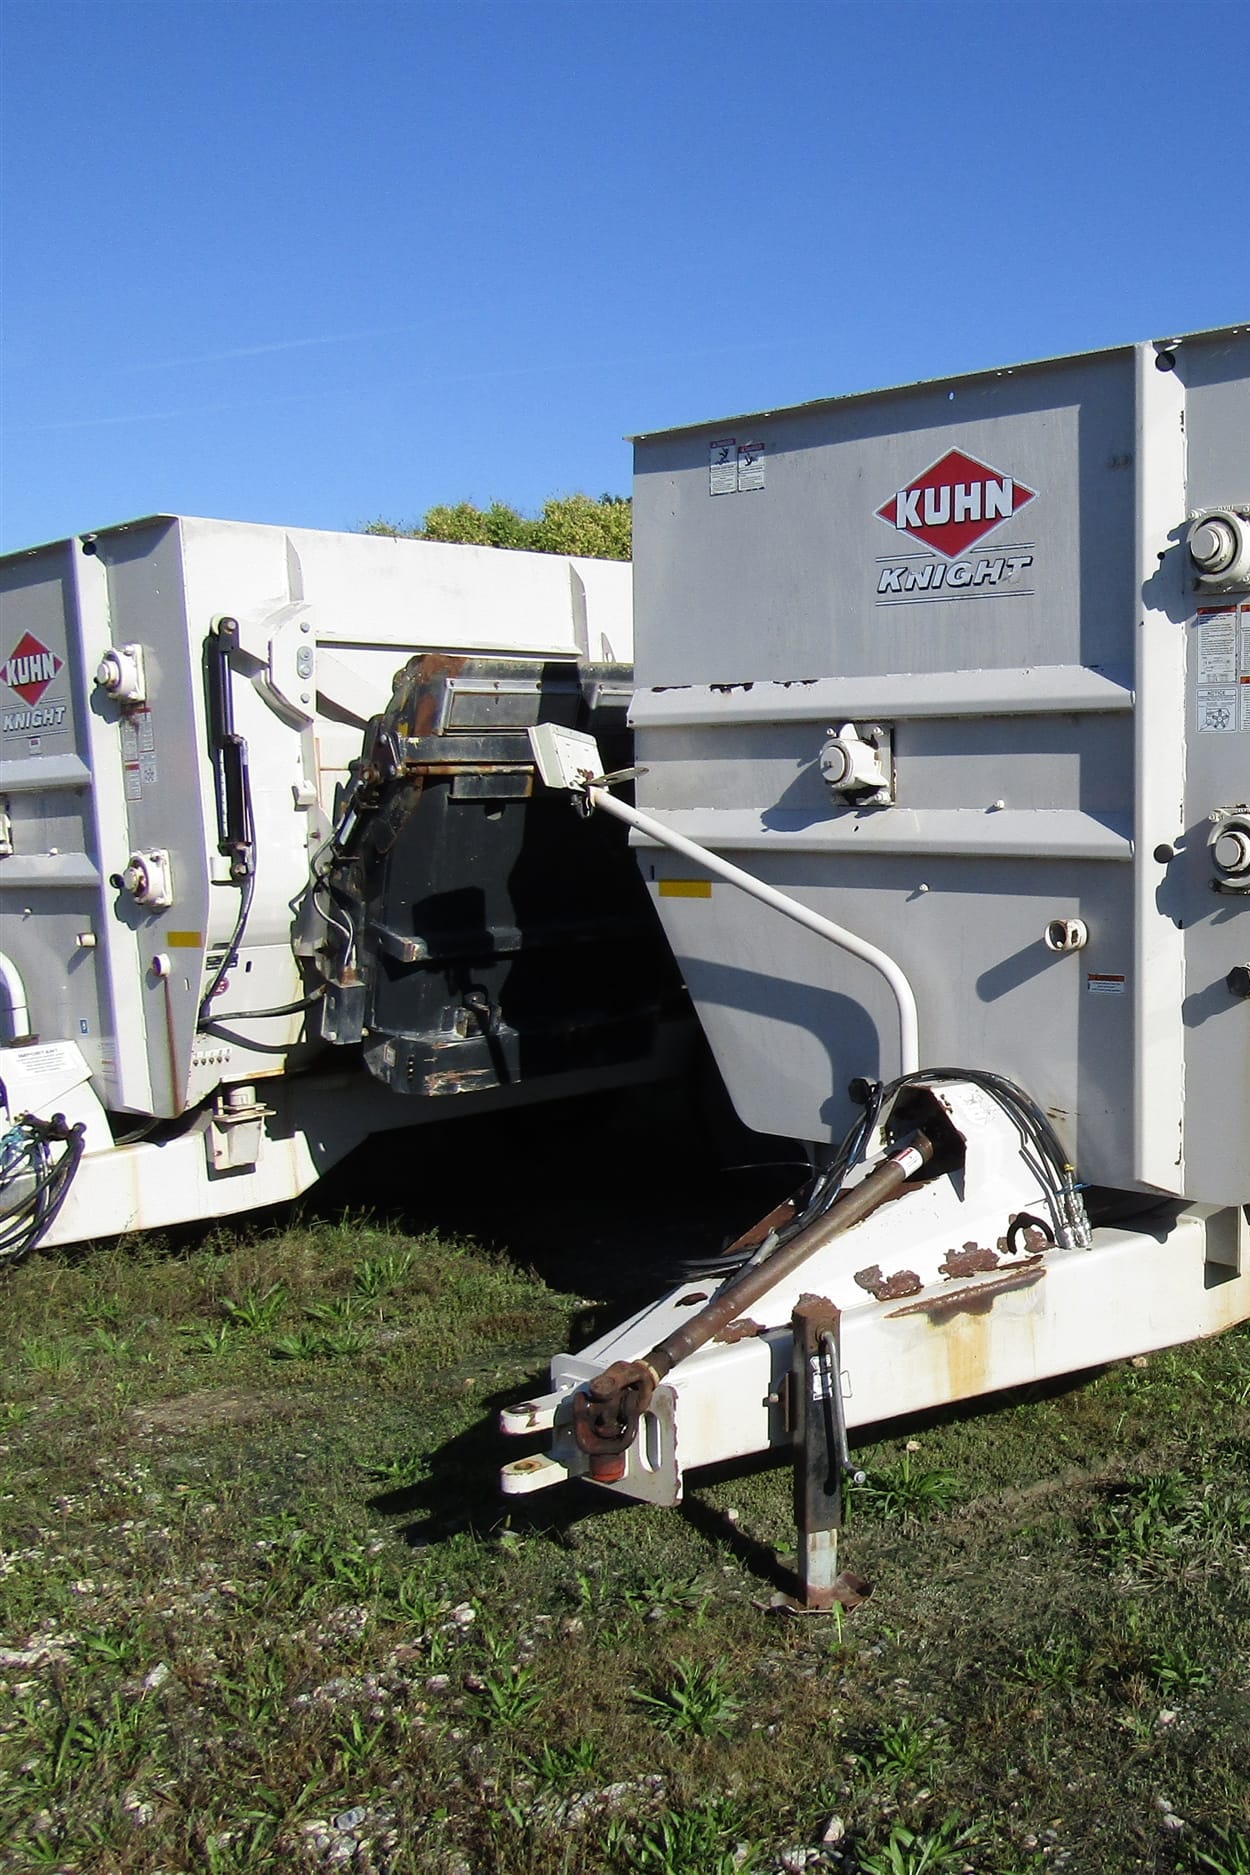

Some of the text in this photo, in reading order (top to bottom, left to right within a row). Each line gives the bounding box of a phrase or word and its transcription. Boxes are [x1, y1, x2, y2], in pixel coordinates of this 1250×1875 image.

[896, 477, 1014, 529] KUHN
[877, 556, 1033, 593] KNIGHT
[6, 652, 56, 687] KUHN
[2, 706, 66, 733] KNIGHT
